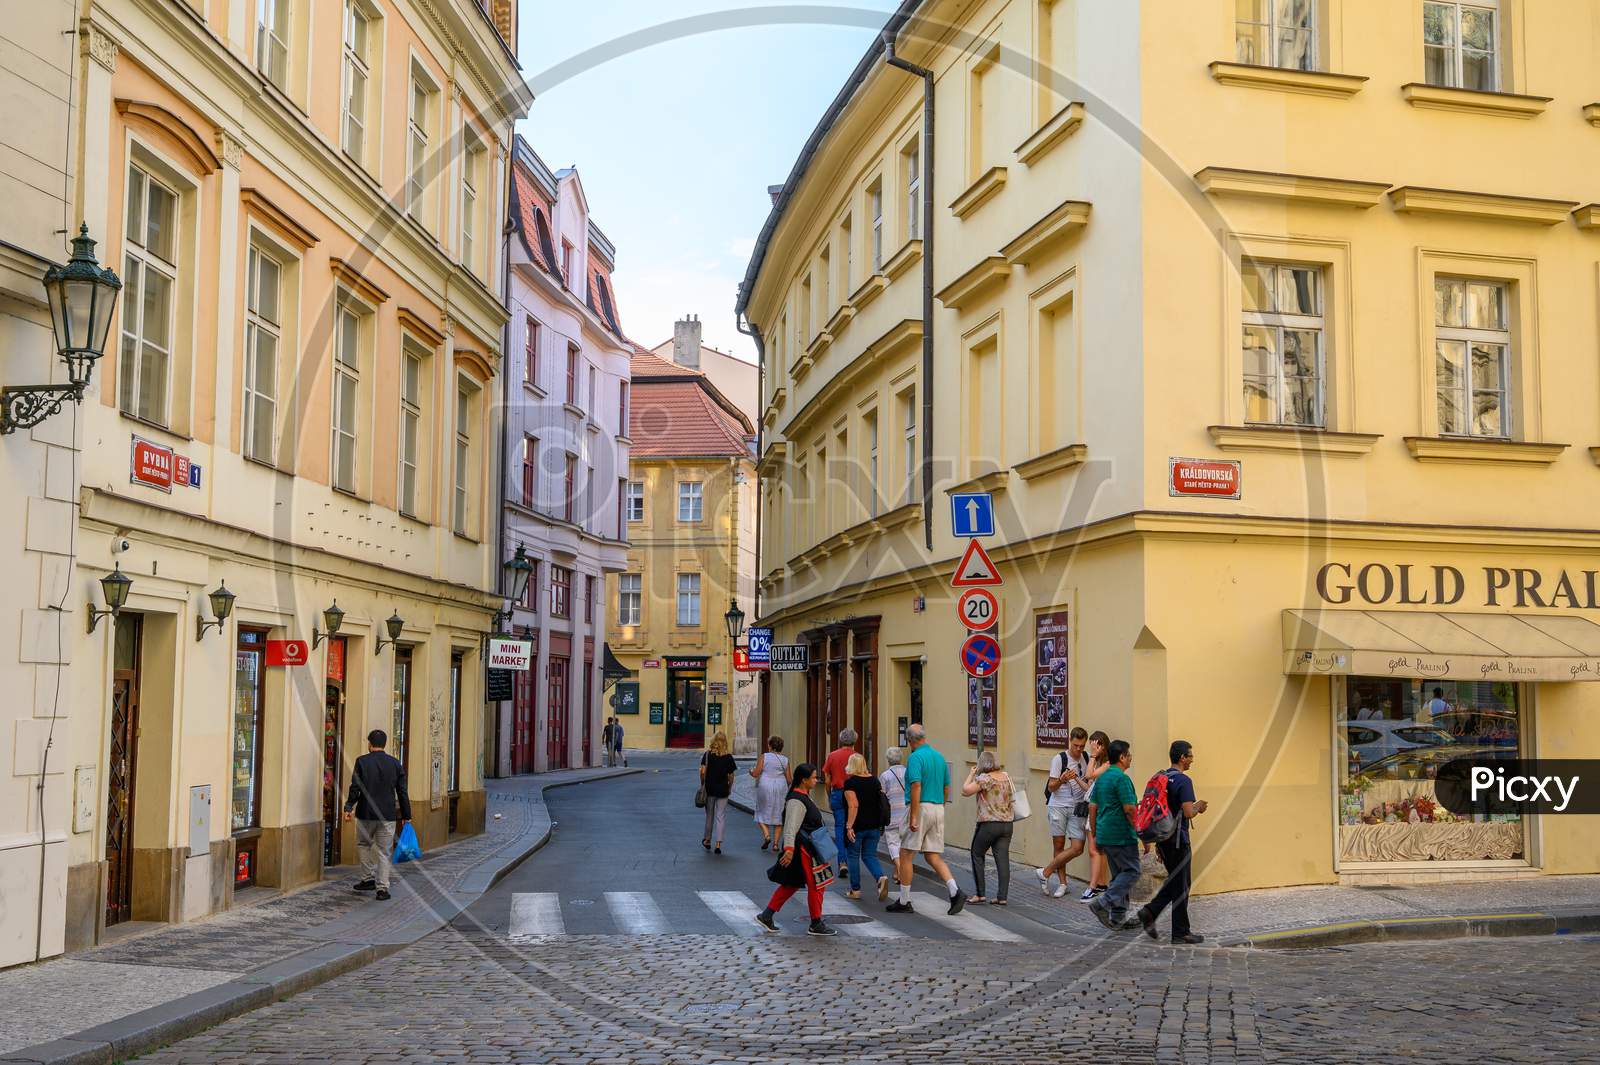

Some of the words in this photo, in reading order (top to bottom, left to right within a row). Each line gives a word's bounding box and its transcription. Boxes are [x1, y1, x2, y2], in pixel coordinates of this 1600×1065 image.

[143, 450, 170, 470] RYBNÁ
[1180, 467, 1233, 480] KRÁLODVORSKÁ
[1316, 562, 1466, 605] GOLD
[968, 600, 989, 618] 20
[749, 628, 772, 636] CHANGE
[500, 644, 521, 653] MINI
[772, 646, 806, 660] OUTLET
[492, 655, 527, 666] MARKET
[772, 662, 804, 670] COBWEB
